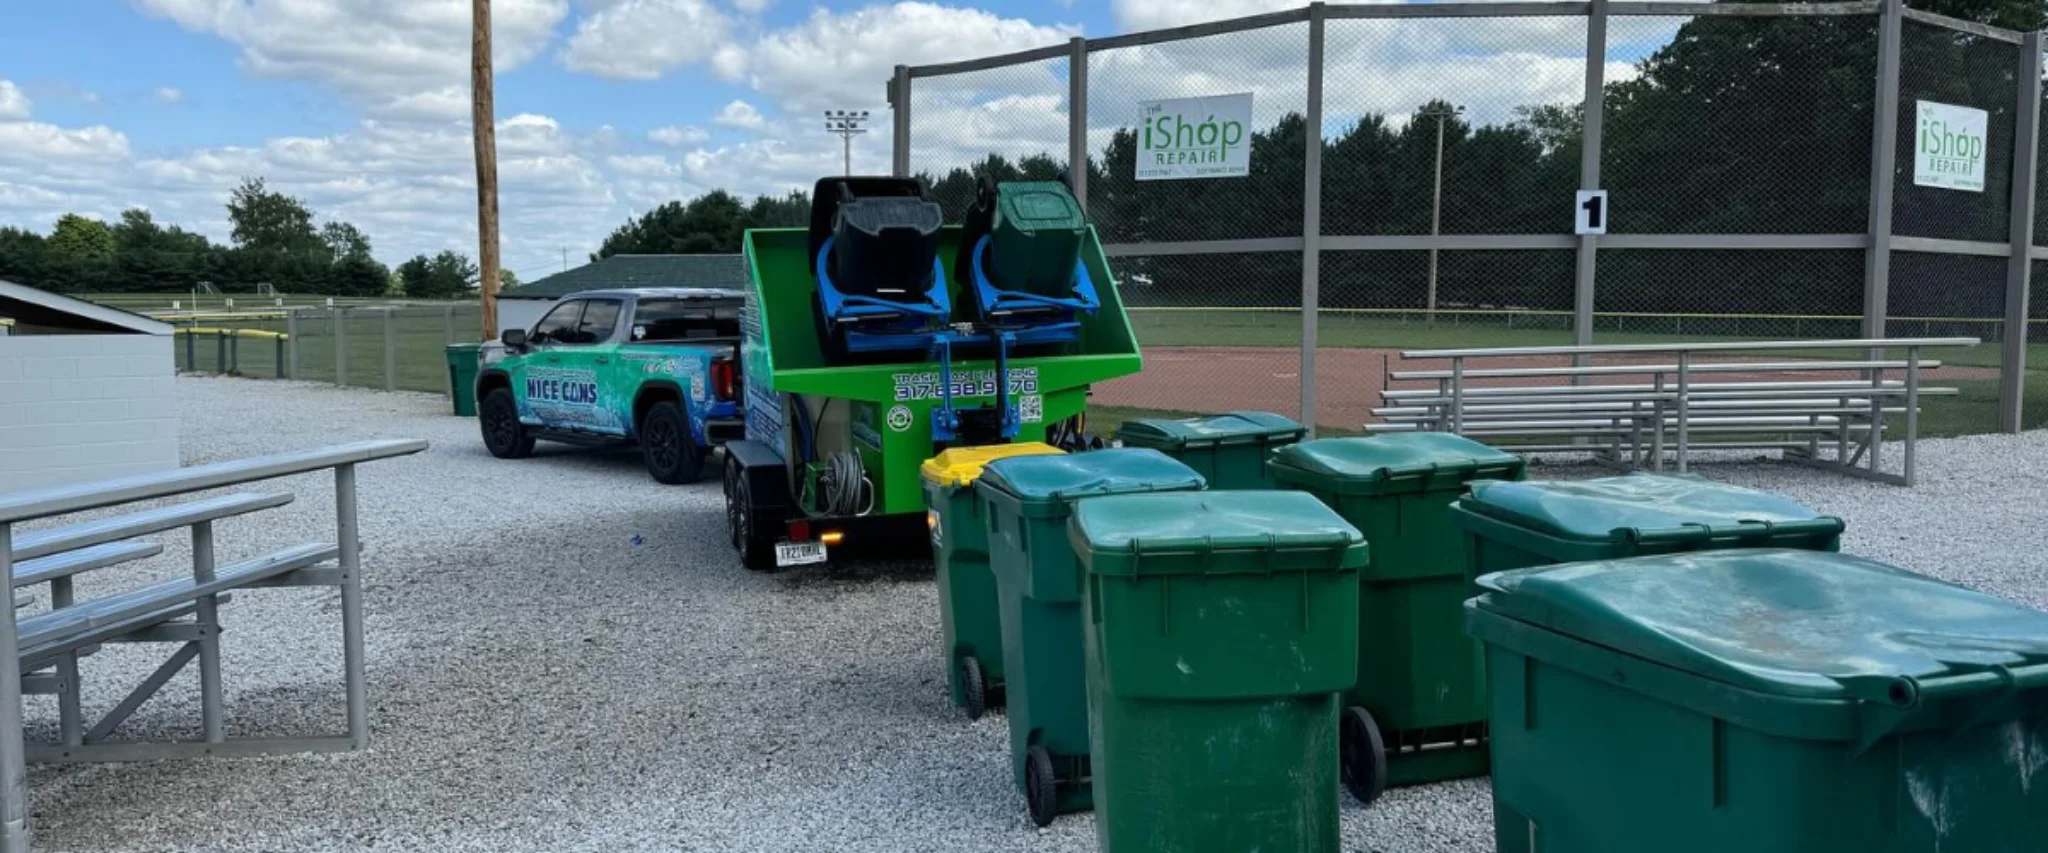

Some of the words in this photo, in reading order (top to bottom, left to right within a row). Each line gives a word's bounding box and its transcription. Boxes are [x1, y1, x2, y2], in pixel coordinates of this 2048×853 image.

[1156, 151, 1217, 165] REPAIR
[1582, 196, 1602, 228] 1
[893, 372, 939, 385] TRASH
[526, 378, 559, 400] NICE
[562, 381, 597, 404] CANS
